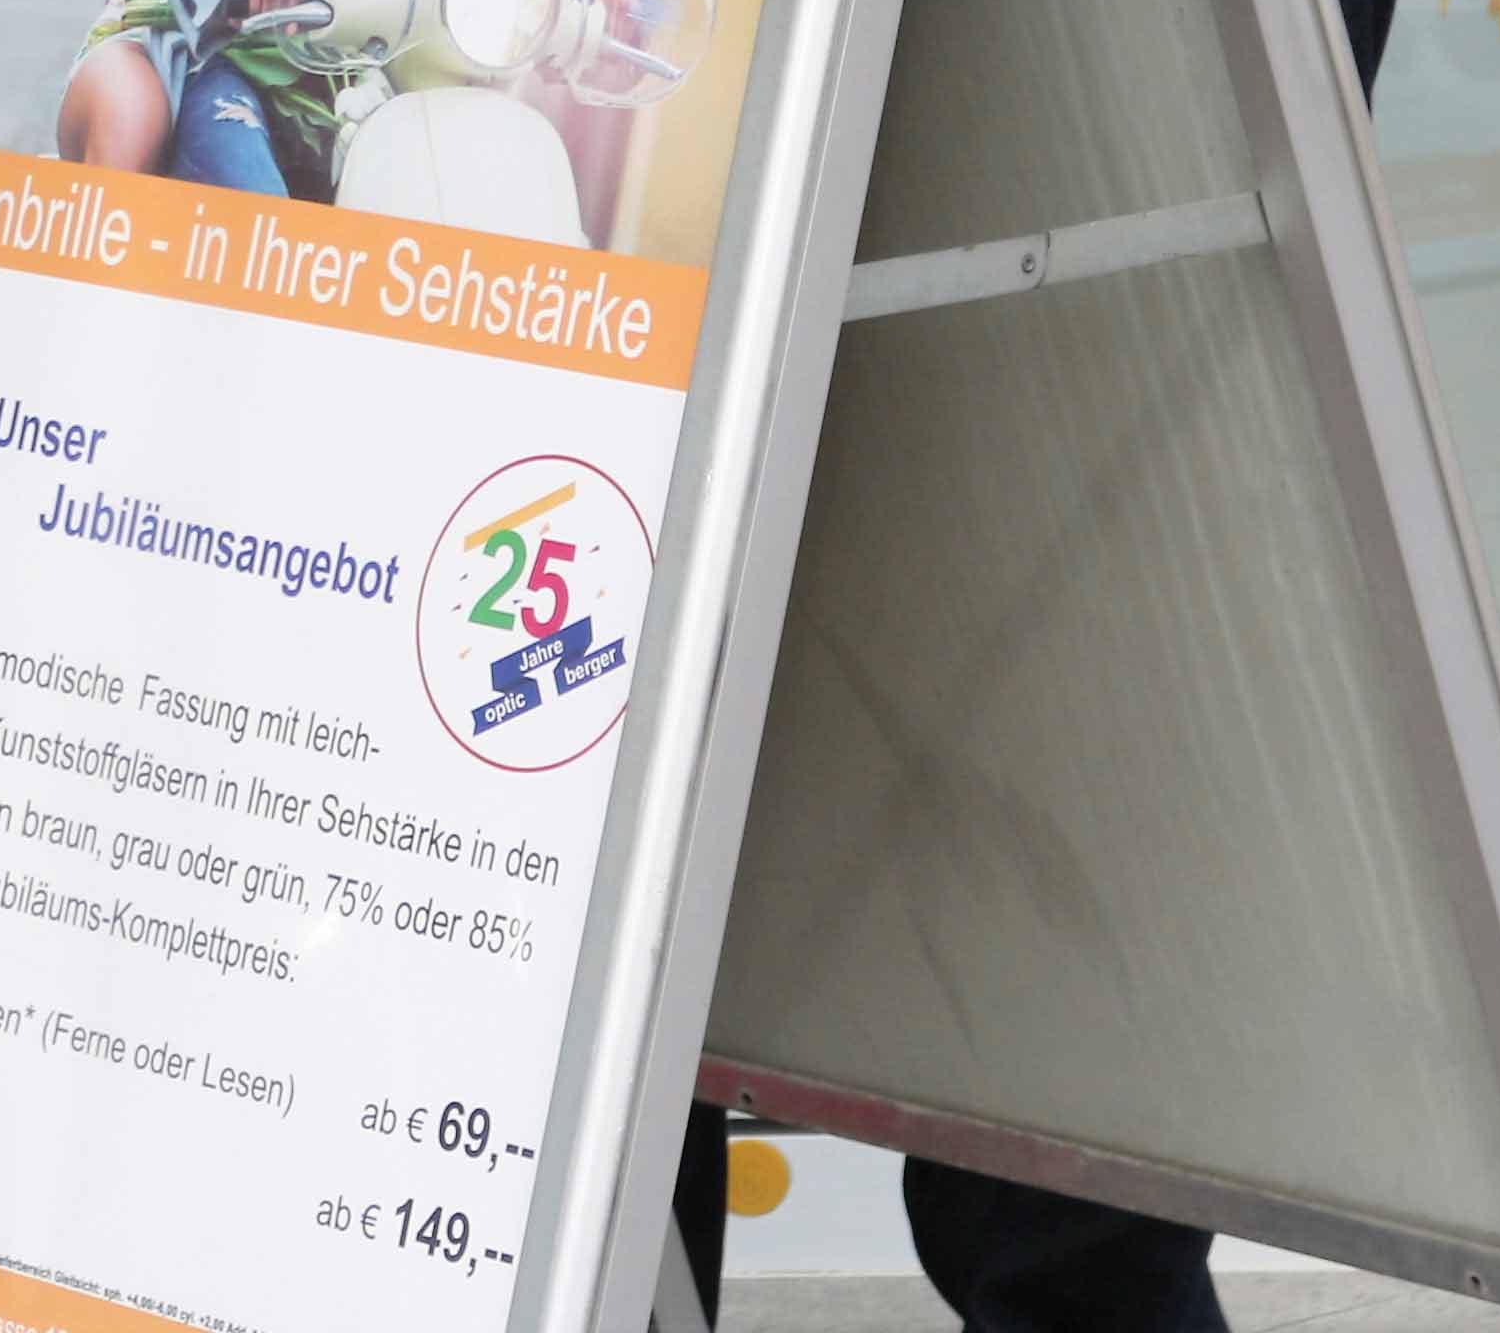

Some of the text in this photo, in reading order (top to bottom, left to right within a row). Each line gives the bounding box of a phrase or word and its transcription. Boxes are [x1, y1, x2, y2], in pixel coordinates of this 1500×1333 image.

[184, 203, 228, 284] in
[242, 213, 368, 307] Ihrer
[379, 237, 652, 359] Sehstärke
[39, 484, 400, 604] Jubiläumsangebot
[467, 528, 577, 641] 25
[484, 646, 617, 723] optic berger
[519, 638, 564, 672] Jahre
[139, 674, 250, 744] Fassung
[256, 706, 300, 747] mit
[305, 710, 381, 763] leich-
[22, 799, 102, 861] braun,
[110, 831, 171, 871] grau
[177, 844, 239, 888] oder
[242, 863, 310, 913] grün,
[324, 874, 384, 925] 75%
[394, 898, 463, 942] oder
[469, 910, 533, 962] 85%
[215, 769, 239, 810] in
[247, 776, 312, 827] Ihrer
[318, 793, 463, 862] Sehstärke
[470, 829, 497, 871] in
[506, 839, 560, 886] den
[42, 1010, 126, 1063] (Ferne
[134, 1042, 196, 1081] oder
[202, 1052, 296, 1118] Lesen)
[360, 1098, 535, 1173] ab € 69,--
[316, 1194, 514, 1277] ab € 149,--
